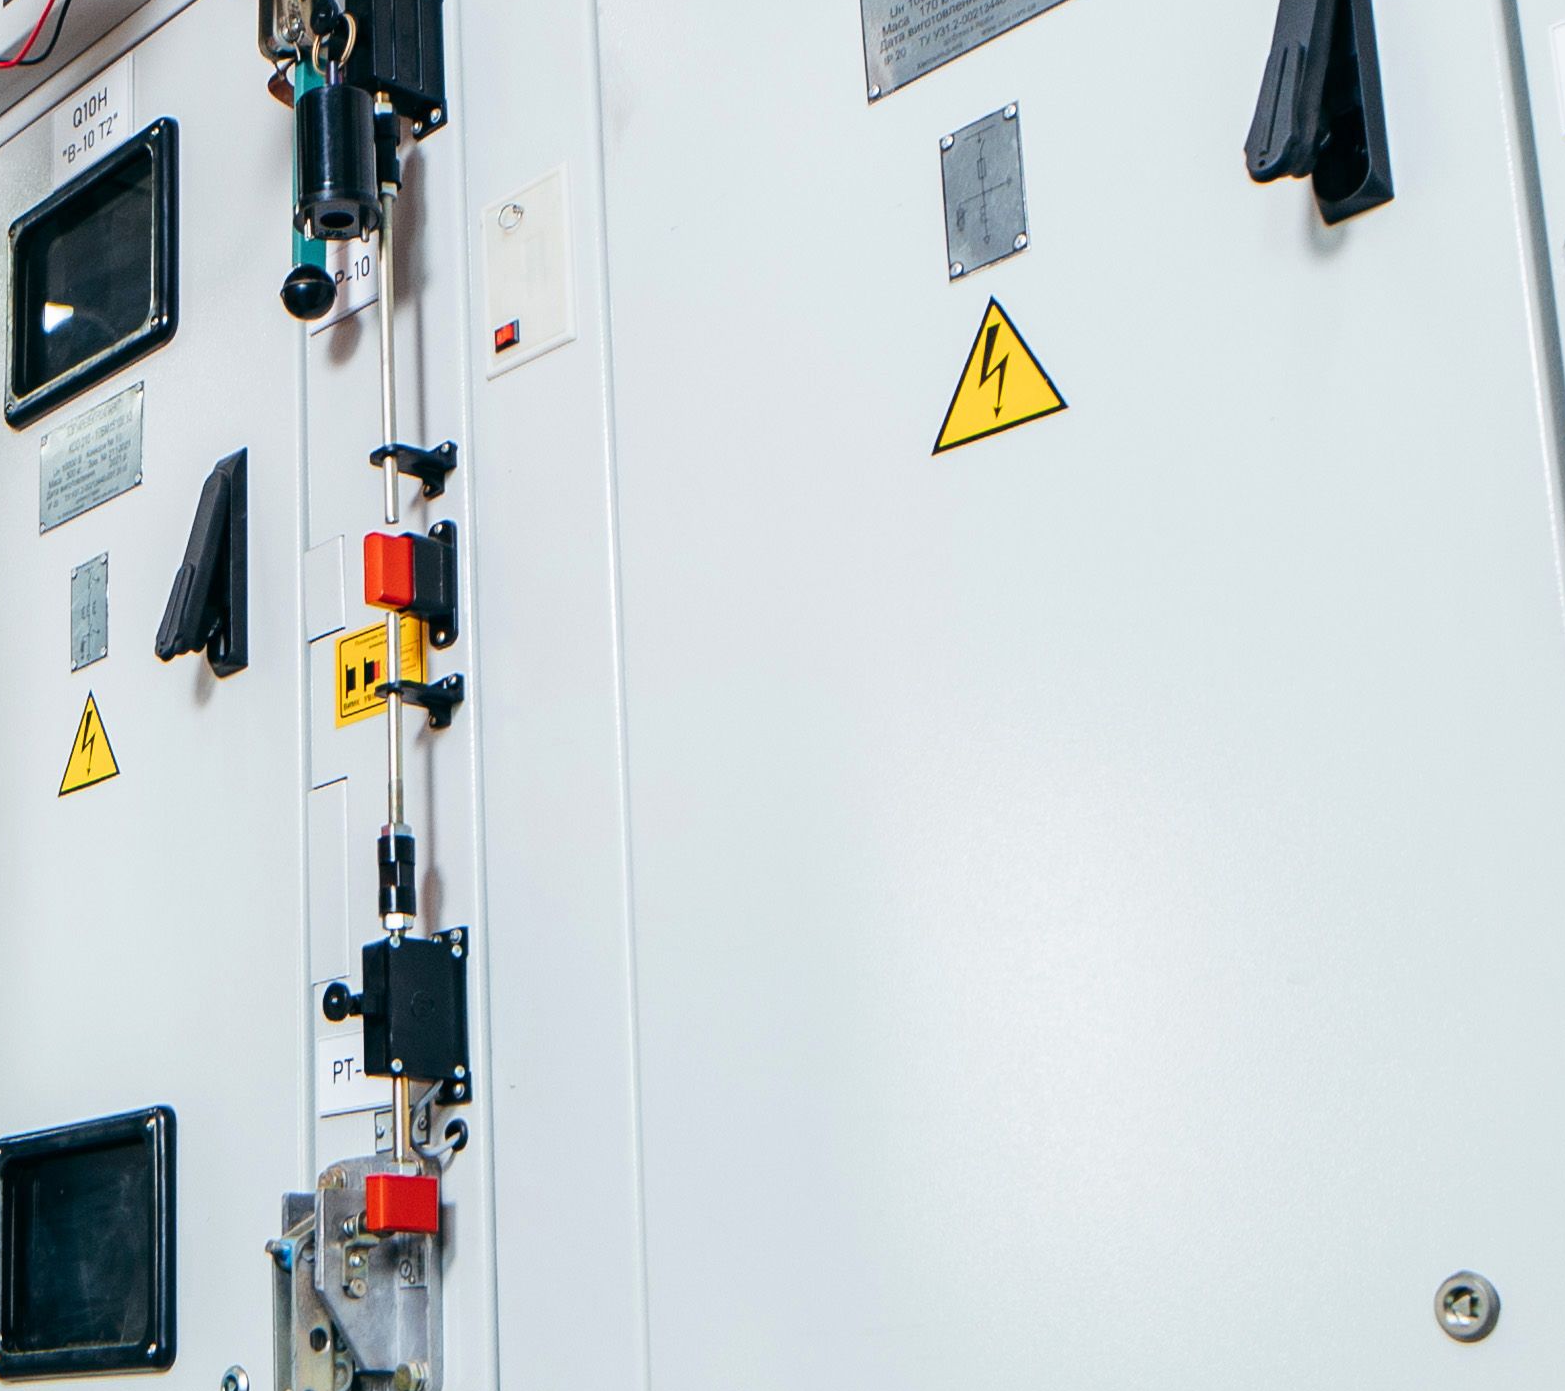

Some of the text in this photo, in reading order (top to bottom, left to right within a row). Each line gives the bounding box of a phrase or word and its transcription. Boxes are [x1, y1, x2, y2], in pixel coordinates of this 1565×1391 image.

[881, 16, 911, 38] Маса
[878, 32, 907, 55] Дата
[895, 47, 907, 61] 20
[334, 254, 370, 297] Р-10
